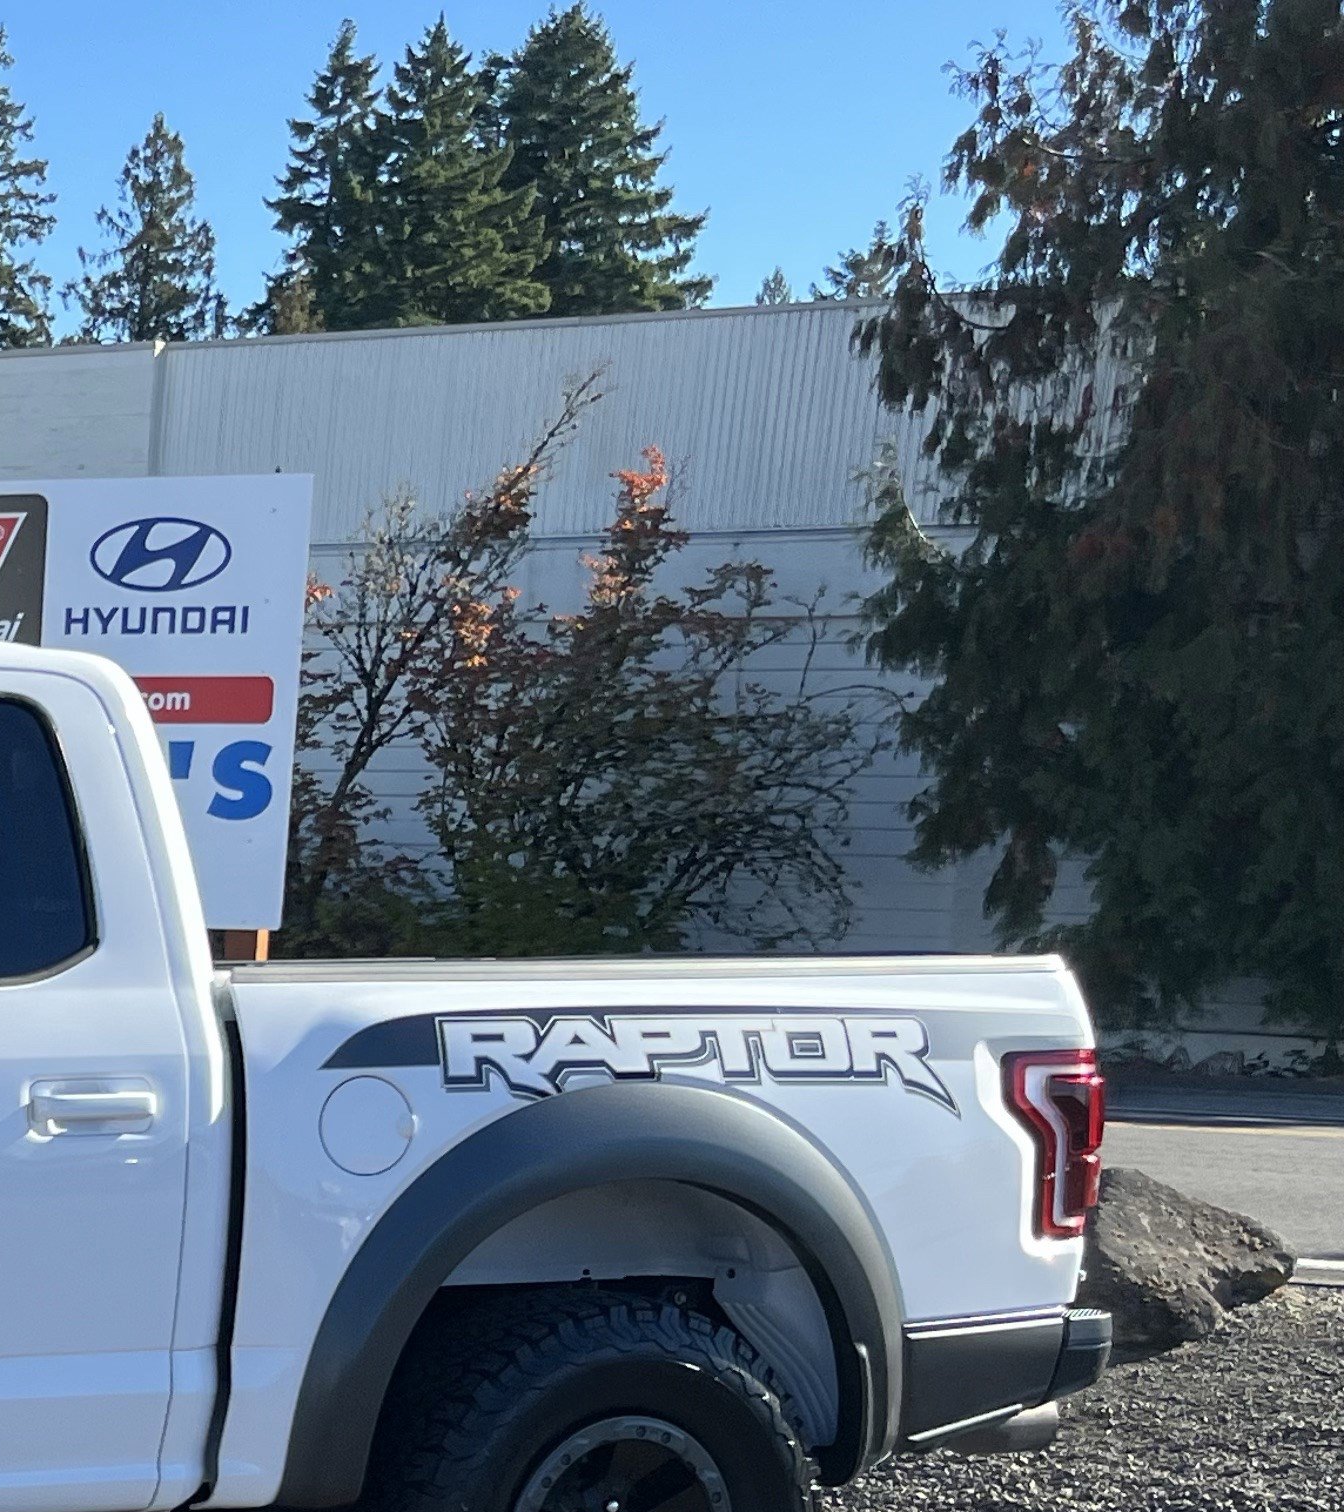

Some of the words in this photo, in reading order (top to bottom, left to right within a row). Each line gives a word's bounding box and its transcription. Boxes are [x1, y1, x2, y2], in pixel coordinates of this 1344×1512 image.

[65, 606, 249, 635] HYUNDAI
[141, 691, 191, 711] om
[435, 1013, 962, 1119] RAPTOR
